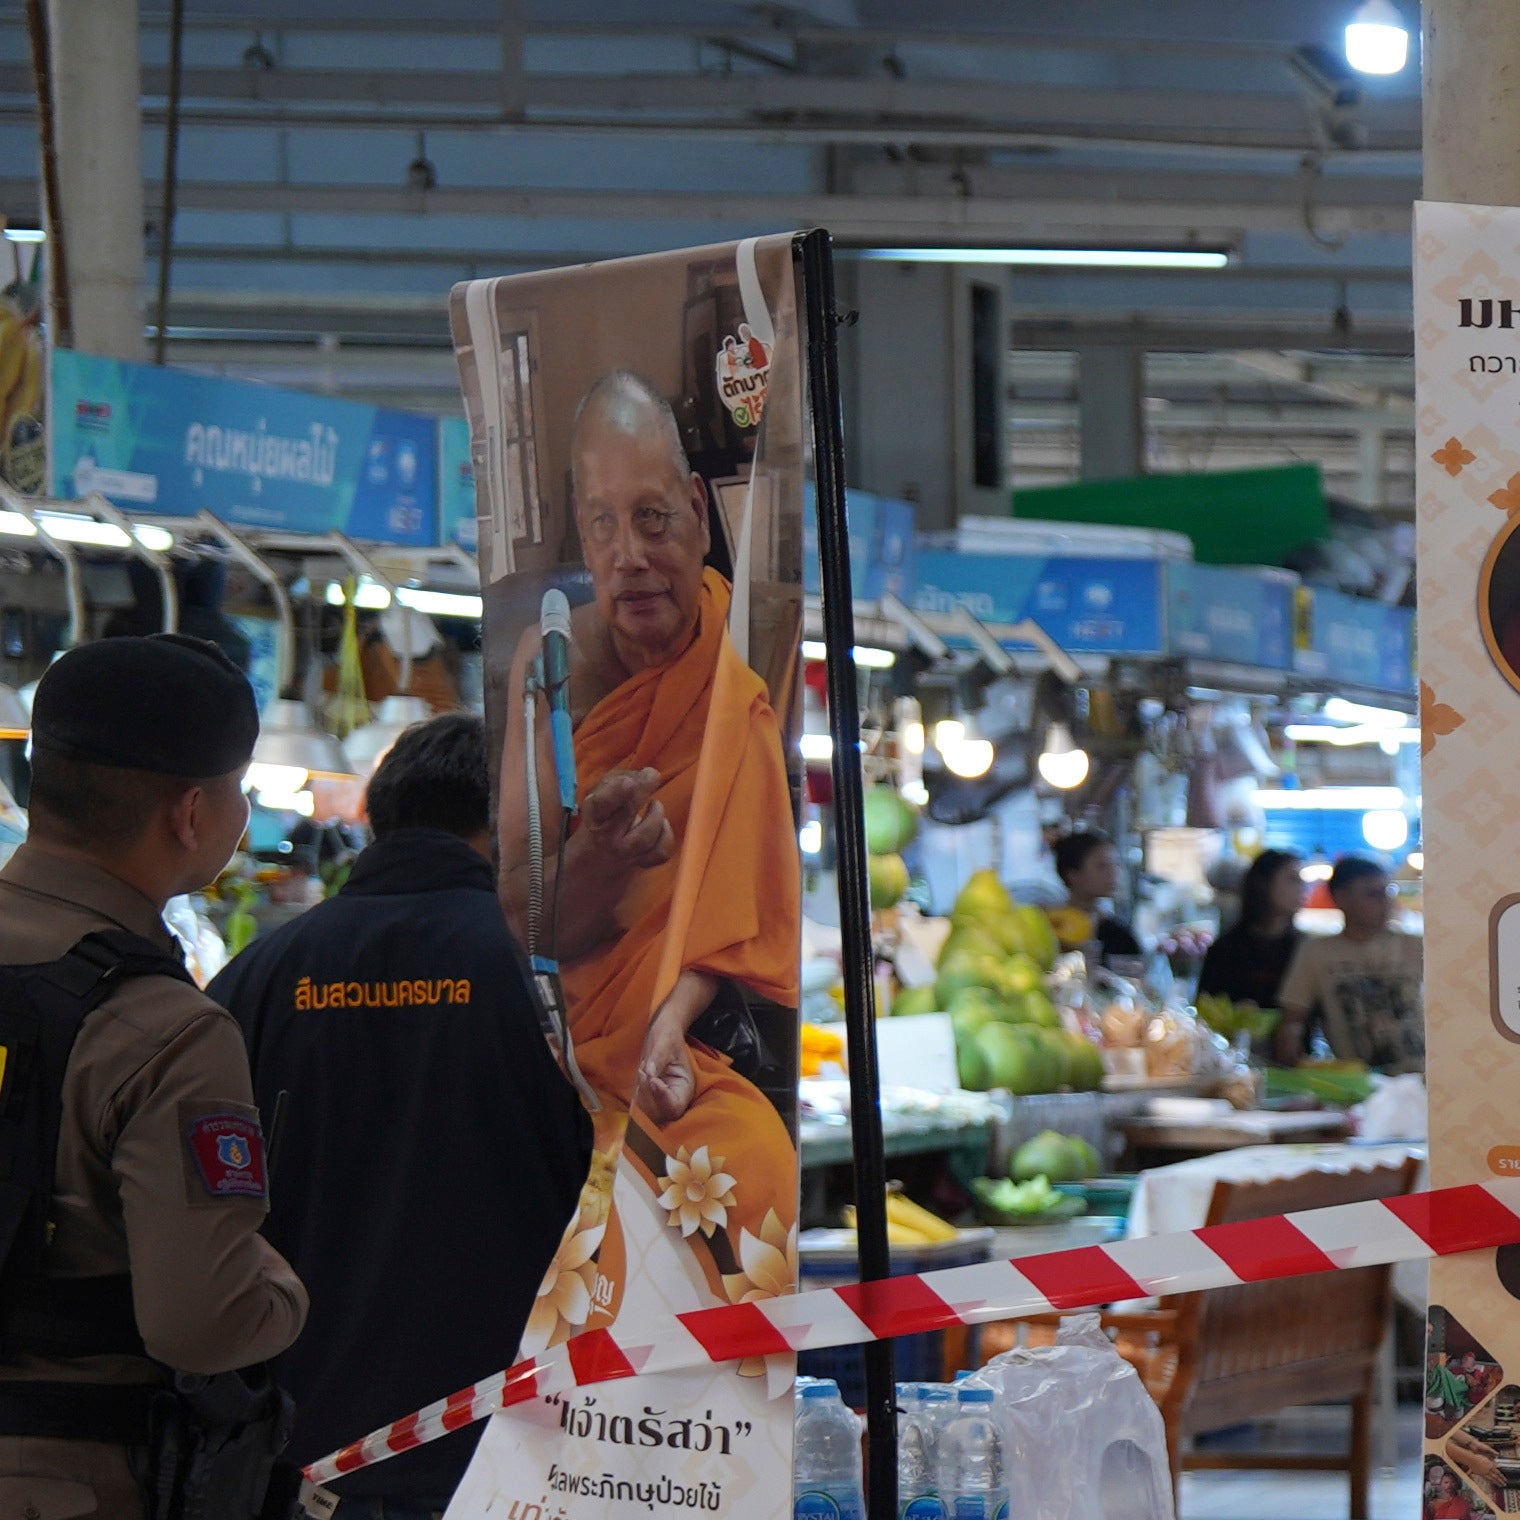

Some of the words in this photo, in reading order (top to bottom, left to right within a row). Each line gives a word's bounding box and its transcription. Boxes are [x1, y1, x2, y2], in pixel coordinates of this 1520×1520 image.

[295, 976, 472, 1011] สืบสวนนครบาล
